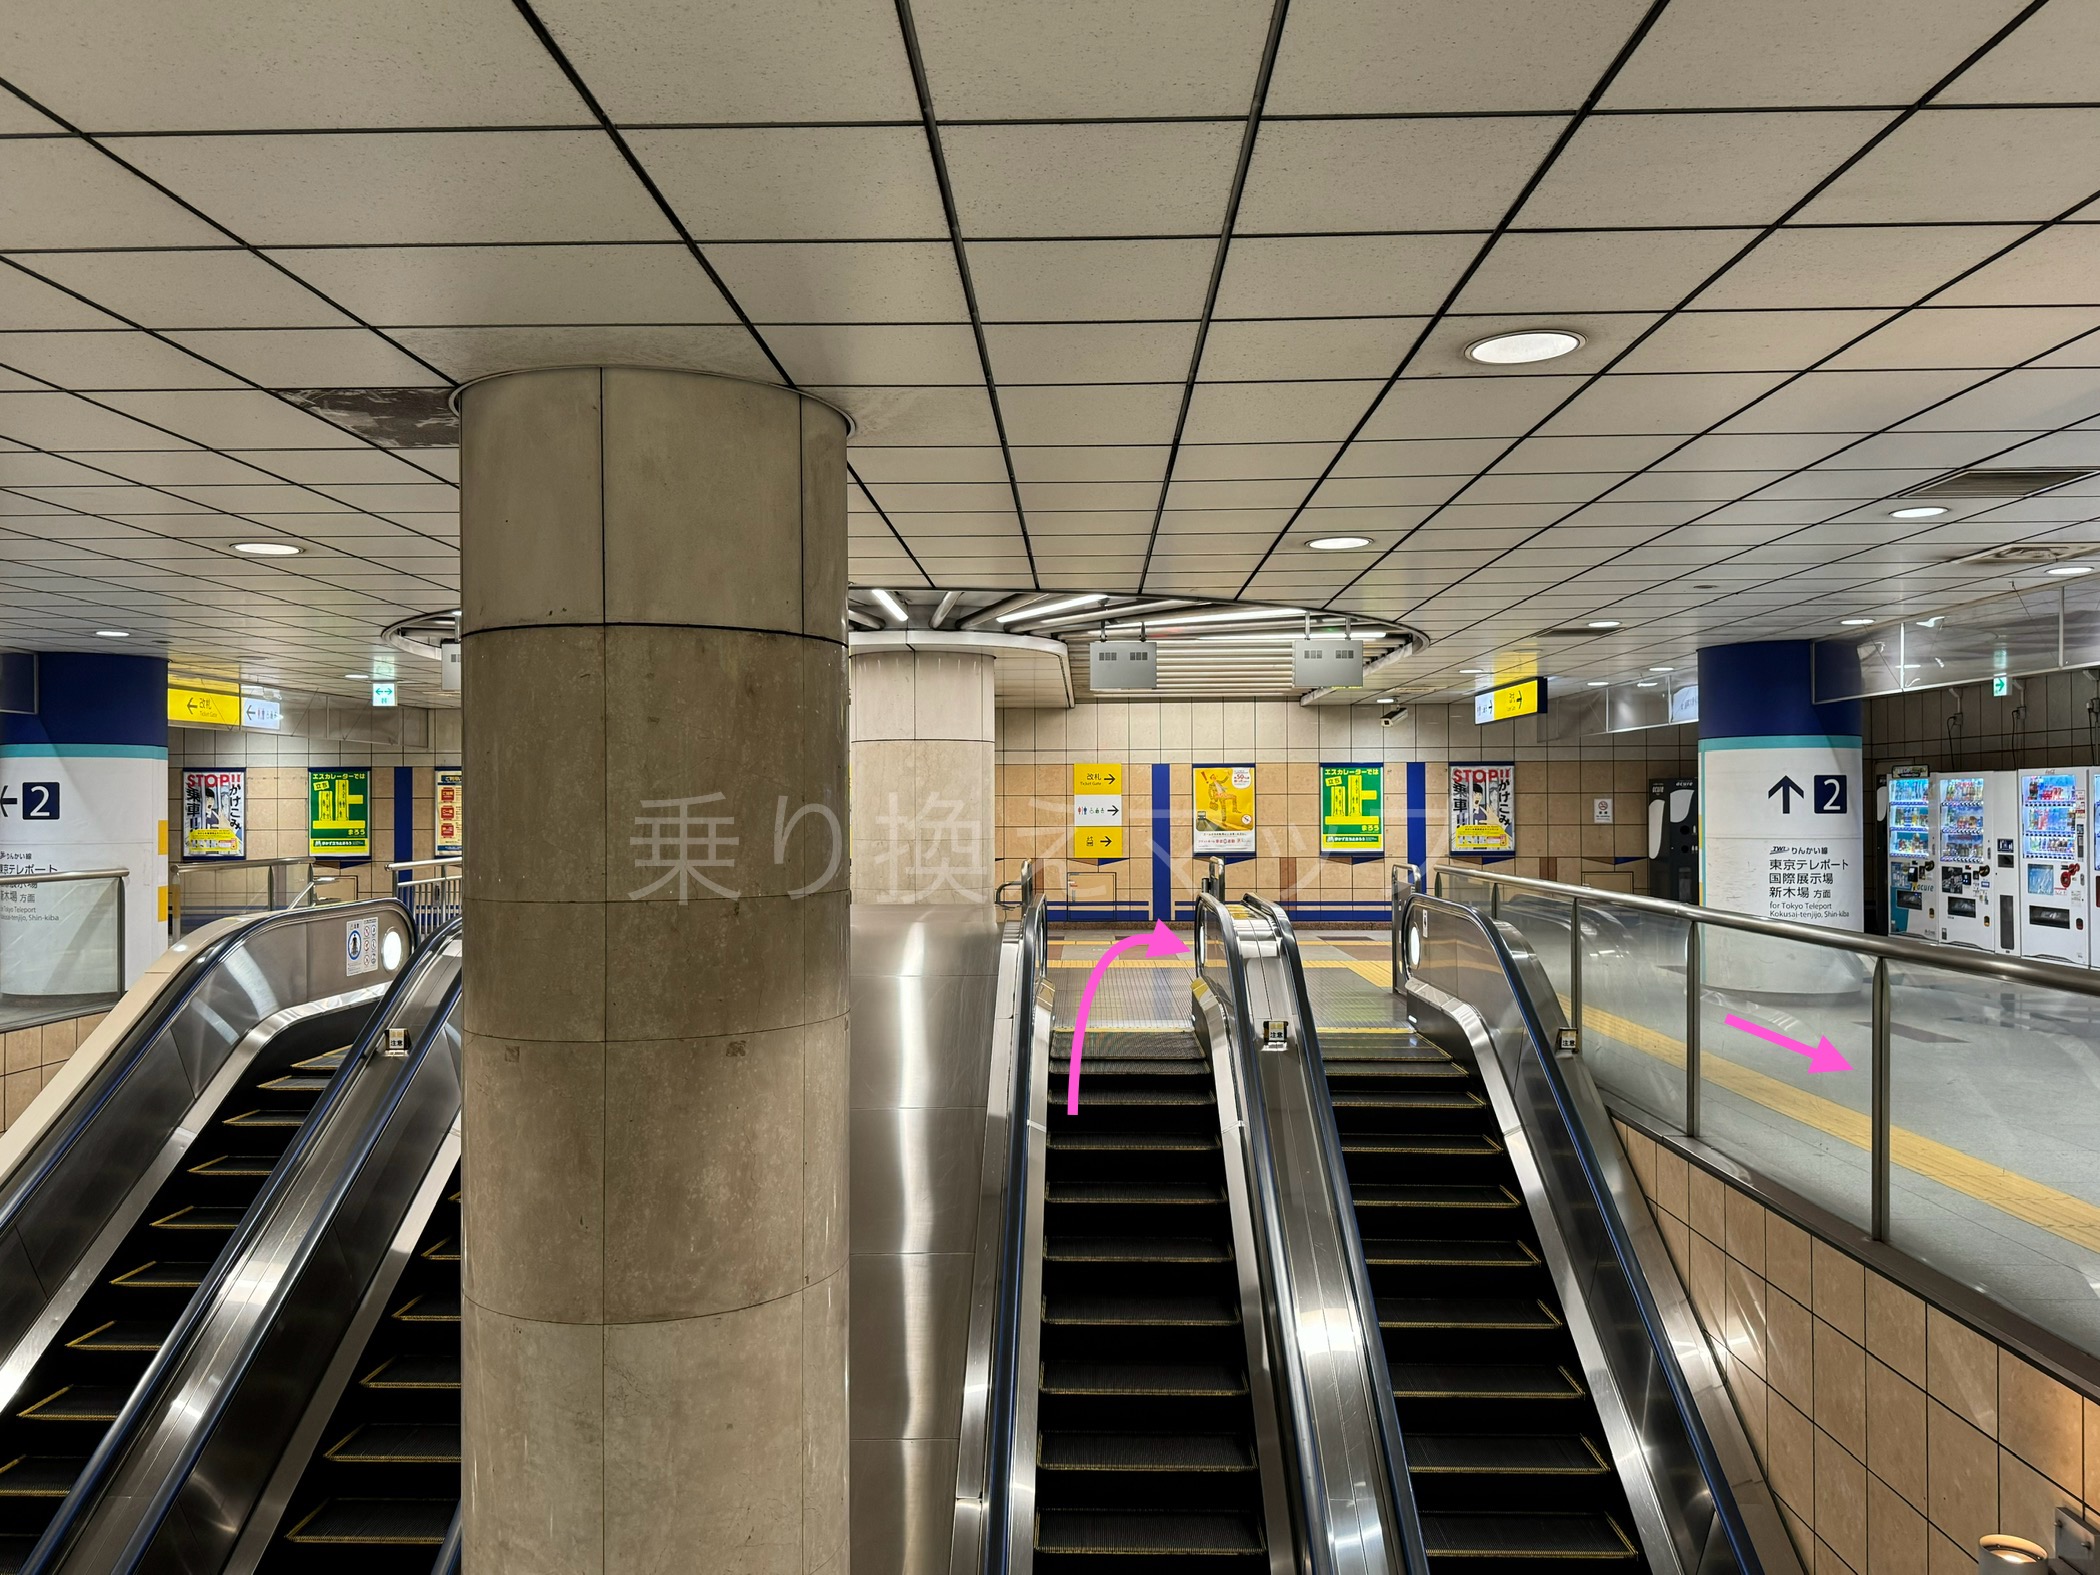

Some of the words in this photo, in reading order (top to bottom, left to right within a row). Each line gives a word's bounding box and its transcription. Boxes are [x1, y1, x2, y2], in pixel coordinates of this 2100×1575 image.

[1086, 773, 1101, 781] 改札
[1324, 768, 1380, 776] エスカレーターでは
[1453, 768, 1511, 784] STOP!!
[186, 773, 241, 788] STOP!!
[1823, 778, 1841, 811] 2
[29, 785, 51, 817] 2
[1498, 779, 1511, 826] かけこみ
[229, 784, 242, 830] かけこみ
[1361, 824, 1379, 832] まろう
[1791, 847, 1828, 855] りんかい線
[1769, 859, 1849, 871] 東京テレポート
[1769, 872, 1834, 885] 国際展示場
[1769, 886, 1810, 899] 新木場
[1813, 889, 1832, 899] 方面
[1916, 883, 1934, 892] acure
[19, 893, 36, 904] 方面
[1769, 900, 1780, 909] for
[1782, 901, 1804, 911] Tokyo
[1805, 901, 1832, 911] Teleport
[1769, 911, 1824, 920] Kokusai-tenjijo,
[391, 1039, 403, 1047] 注意
